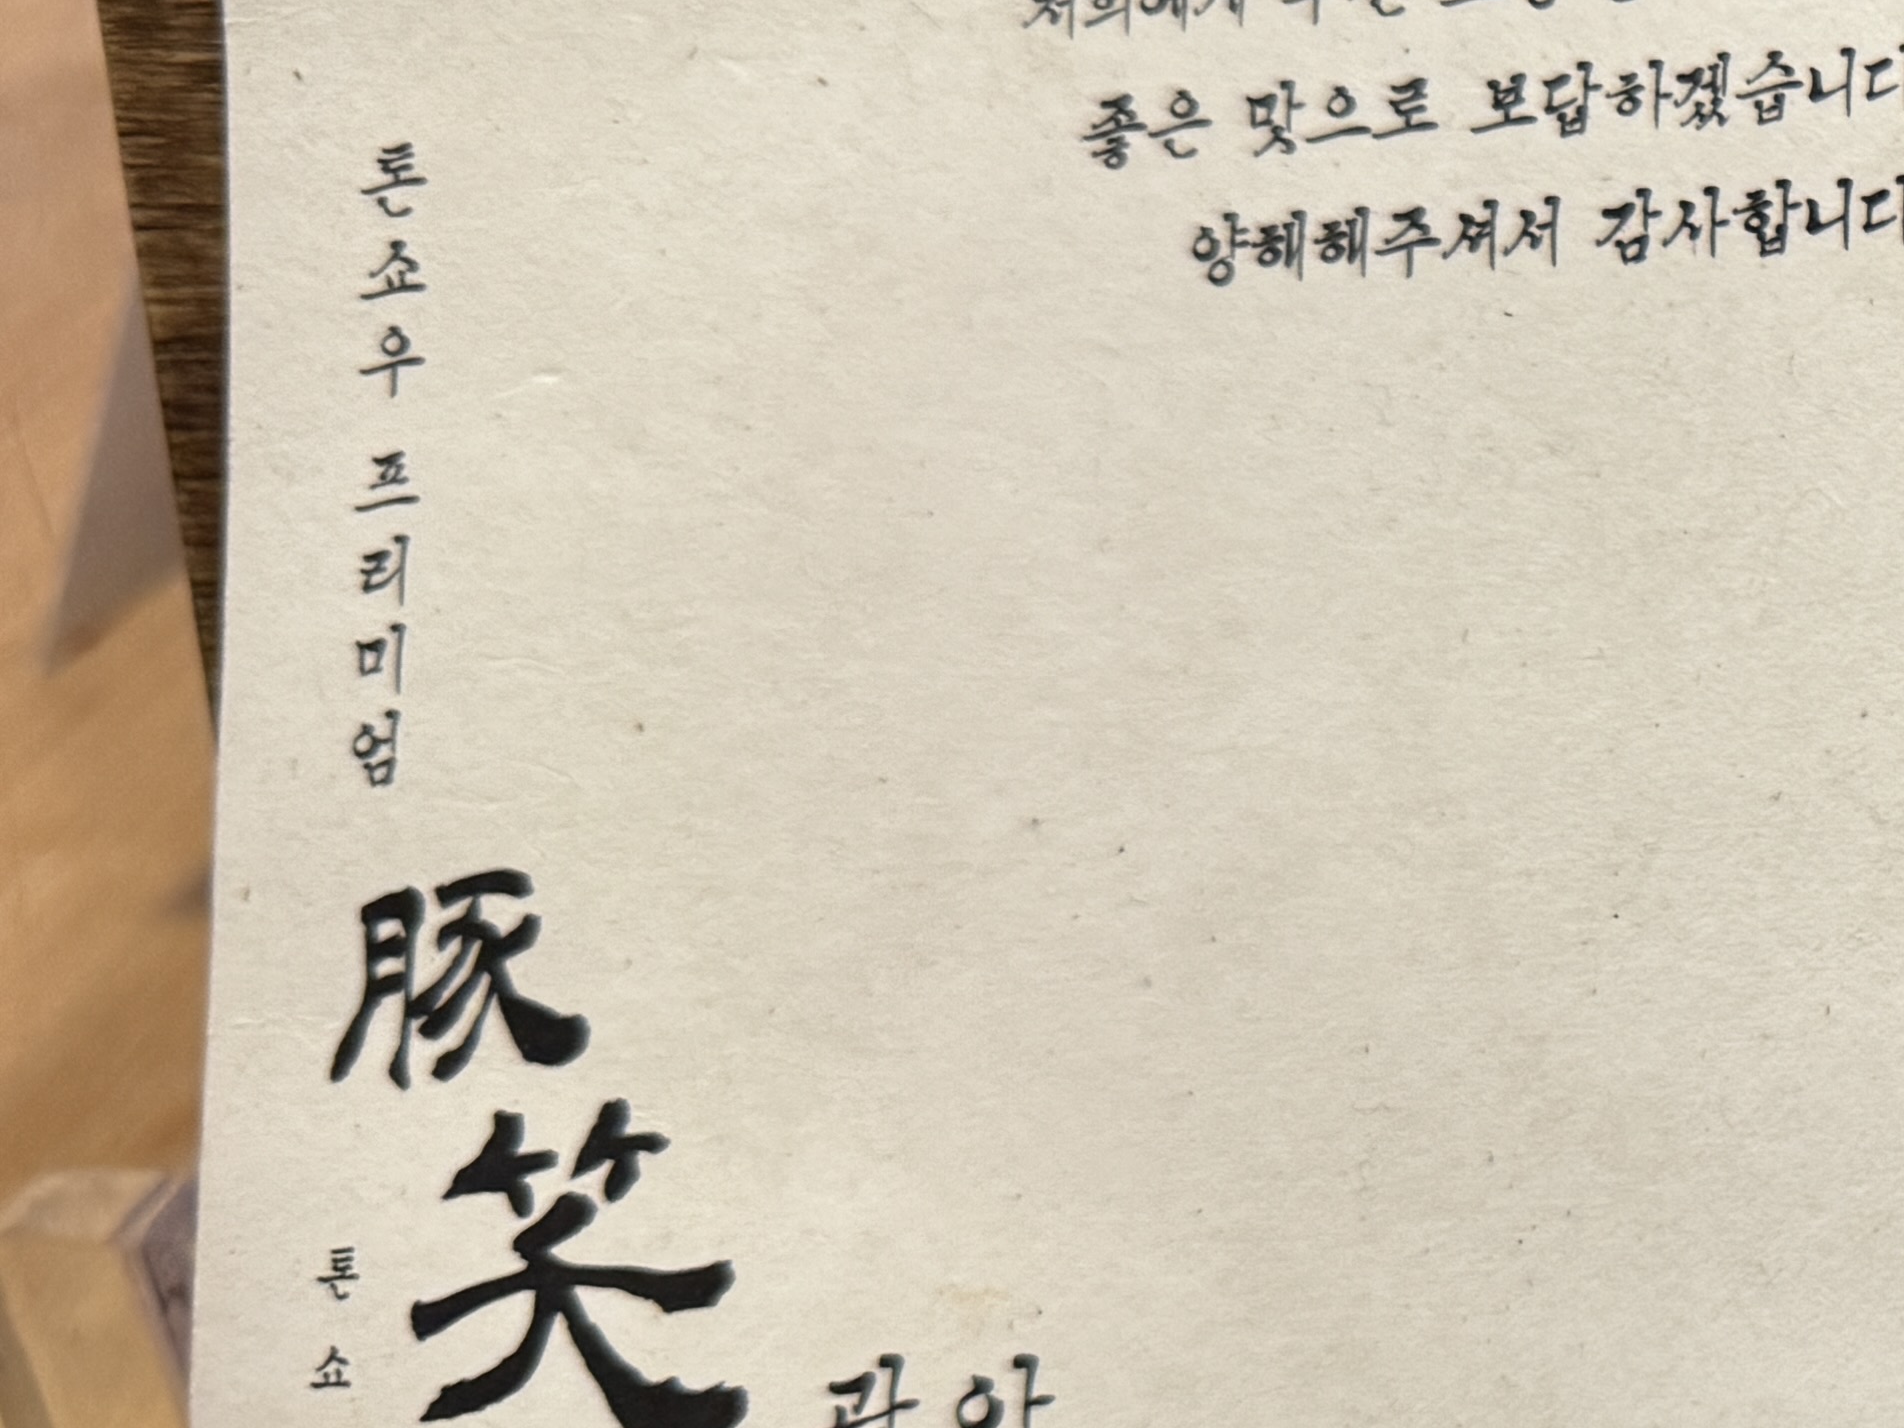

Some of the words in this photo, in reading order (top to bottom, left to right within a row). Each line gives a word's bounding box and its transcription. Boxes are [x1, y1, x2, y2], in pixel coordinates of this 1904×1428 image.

[1080, 88, 1213, 170] 좋은
[1243, 76, 1439, 158] 맛으로
[358, 142, 428, 398] 톤쇼우
[1189, 194, 1561, 287] 양해해주셔서
[349, 450, 420, 788] 프리미엄
